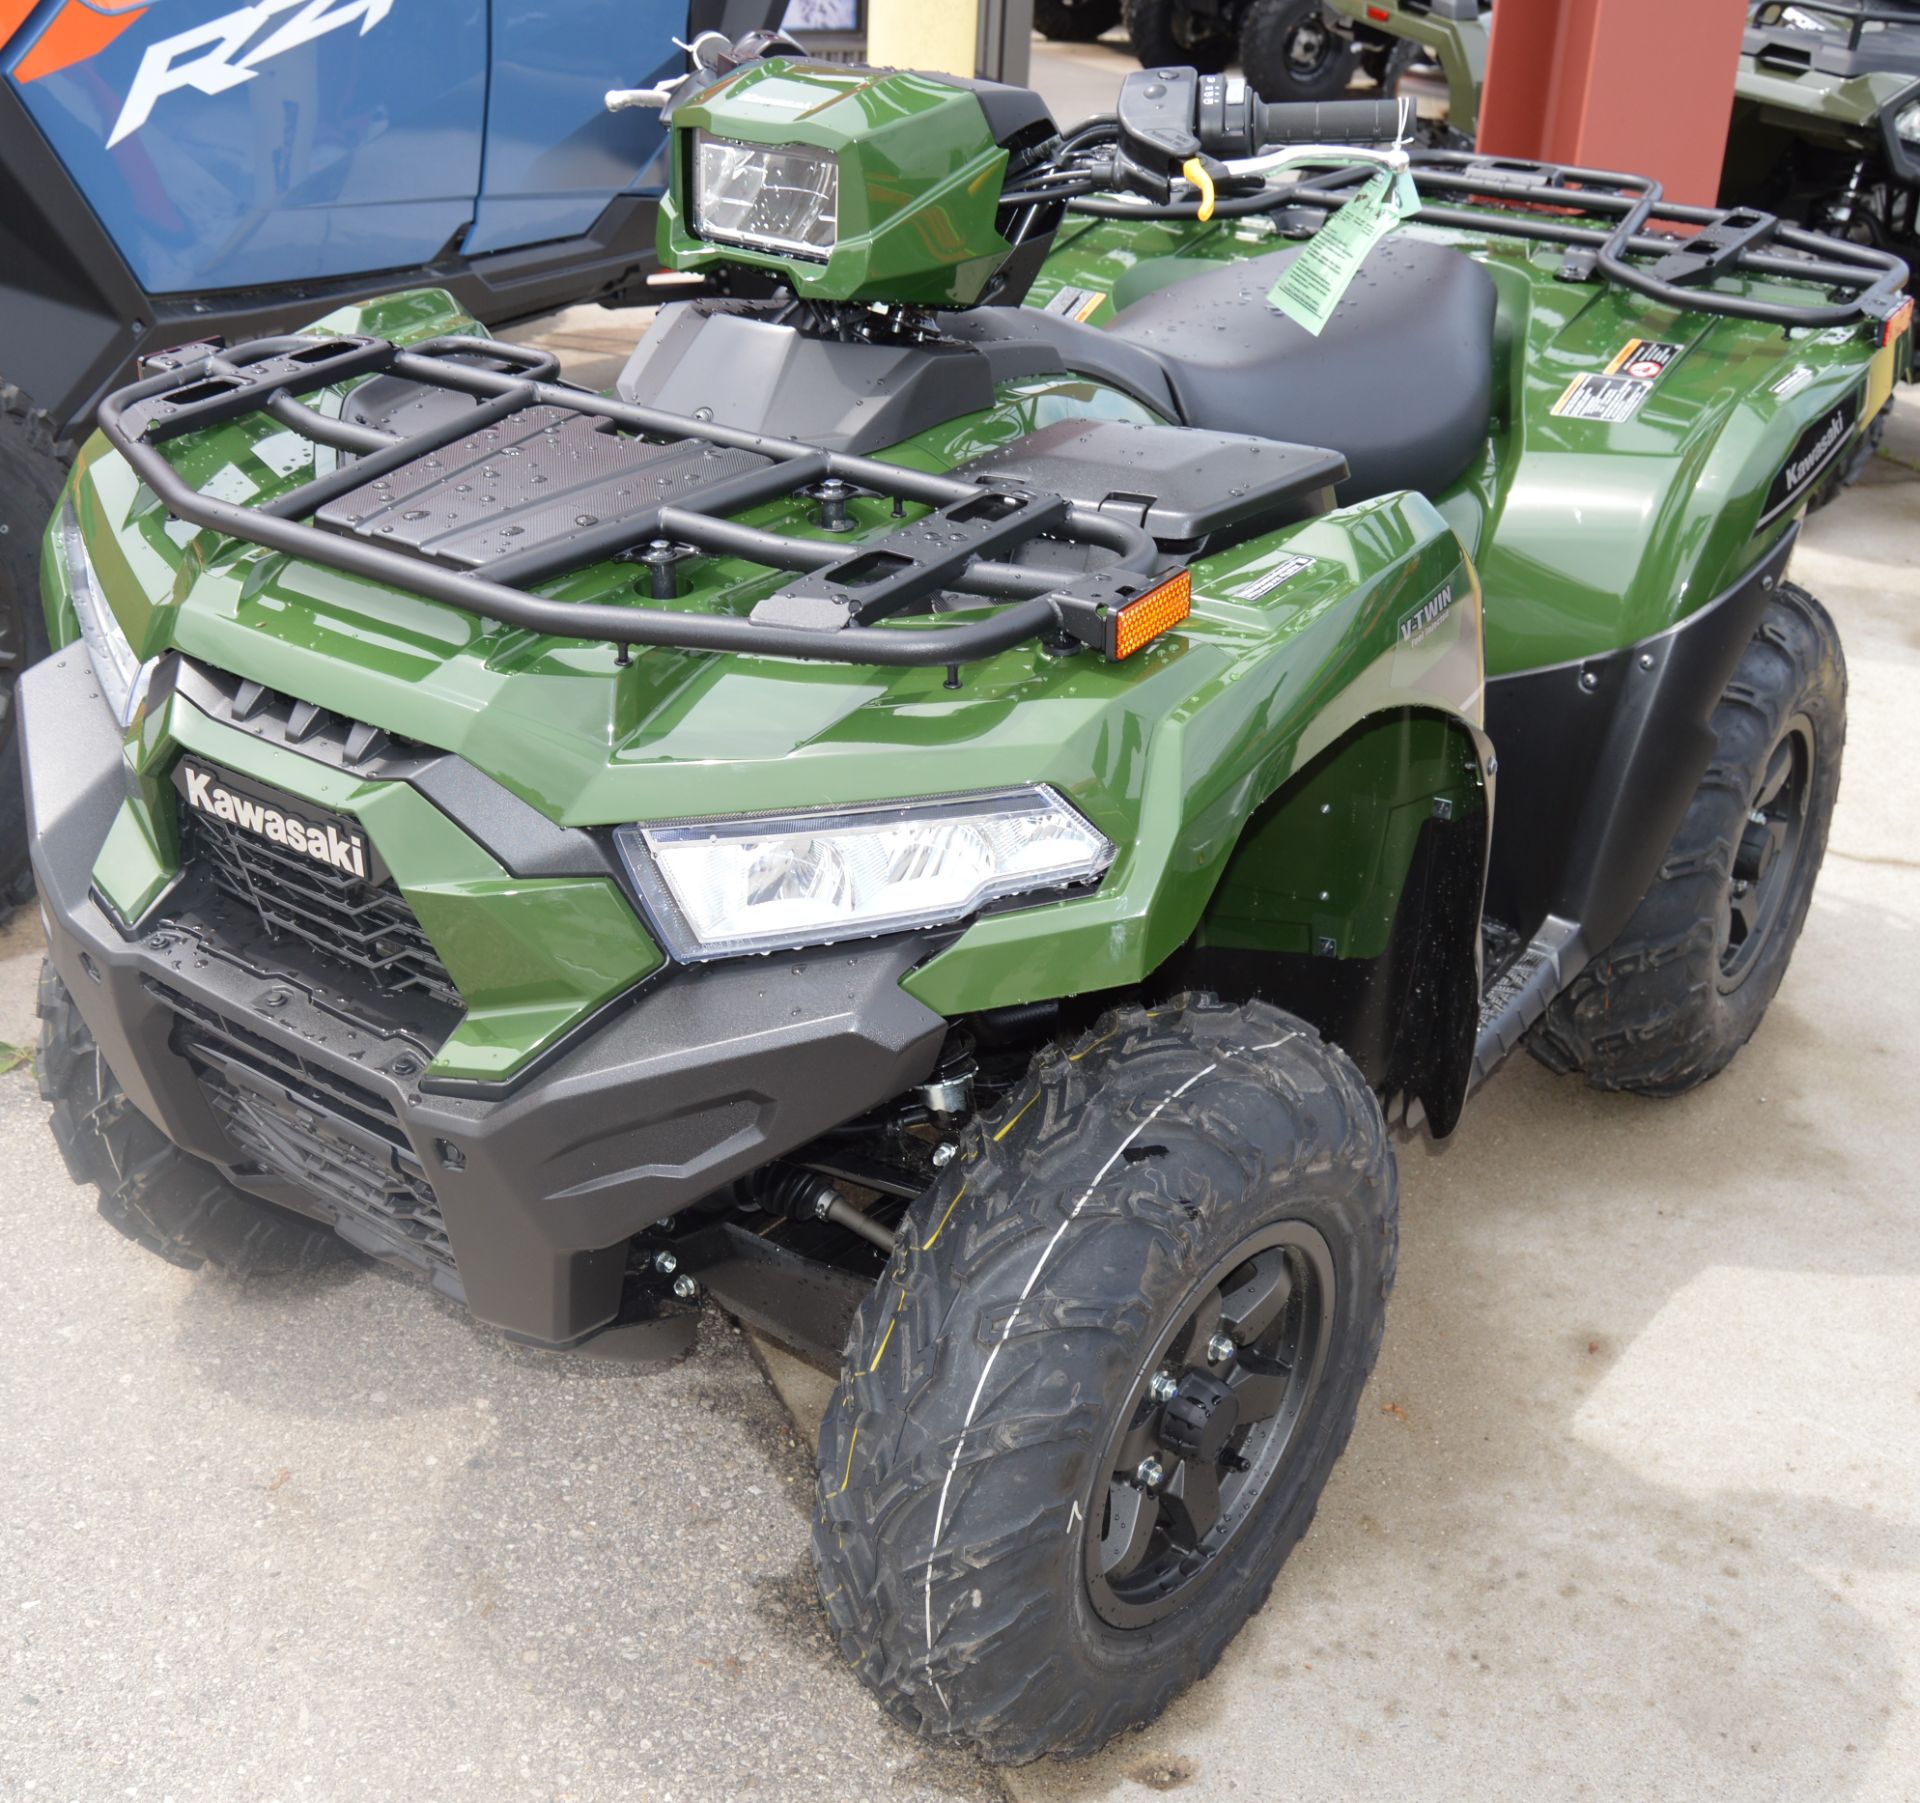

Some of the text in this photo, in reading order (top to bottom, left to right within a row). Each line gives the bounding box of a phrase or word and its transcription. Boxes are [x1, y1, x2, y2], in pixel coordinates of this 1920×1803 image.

[1785, 410, 1844, 491] Kawasaki
[1400, 585, 1452, 641] V-TWIN
[185, 767, 365, 879] Kawasaki
